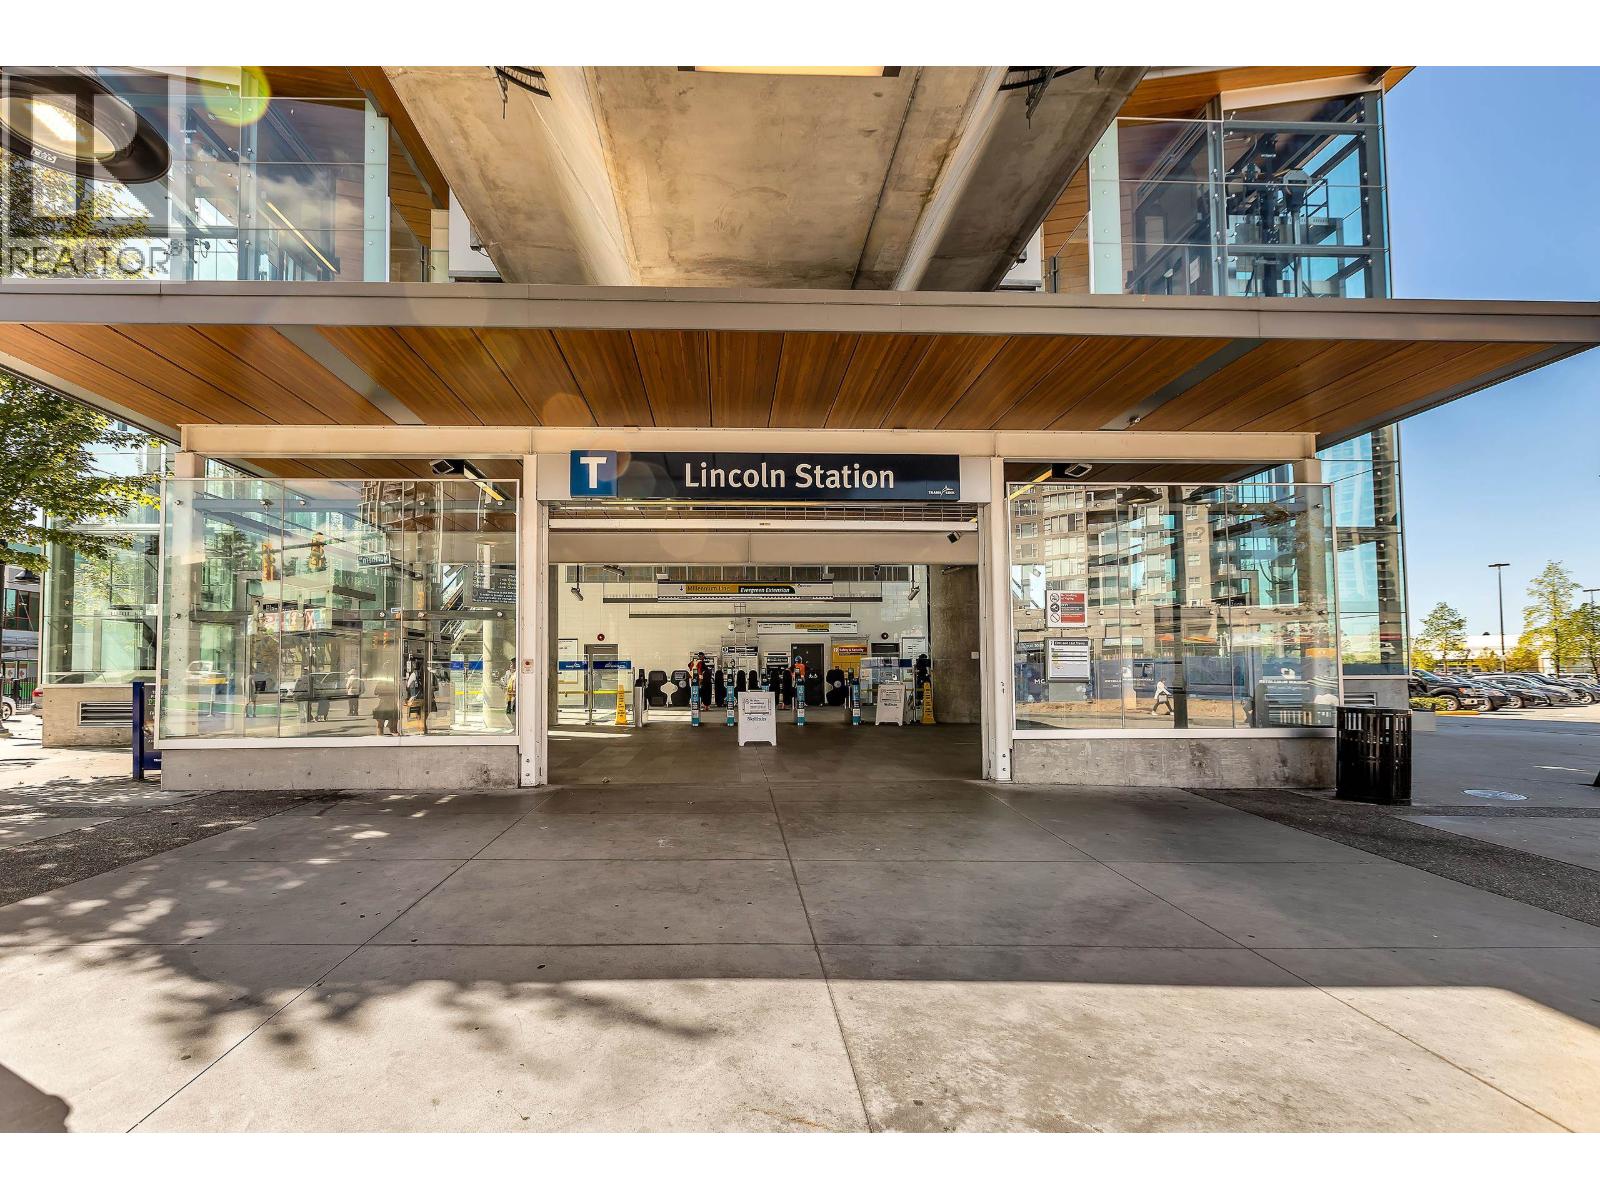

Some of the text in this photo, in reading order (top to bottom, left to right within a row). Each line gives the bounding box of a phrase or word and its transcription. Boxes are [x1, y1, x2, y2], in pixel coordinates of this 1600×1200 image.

[579, 456, 608, 489] T
[685, 461, 895, 490] Lincoln Station
[687, 584, 717, 592] Millennium
[740, 586, 765, 595] Evergreen
